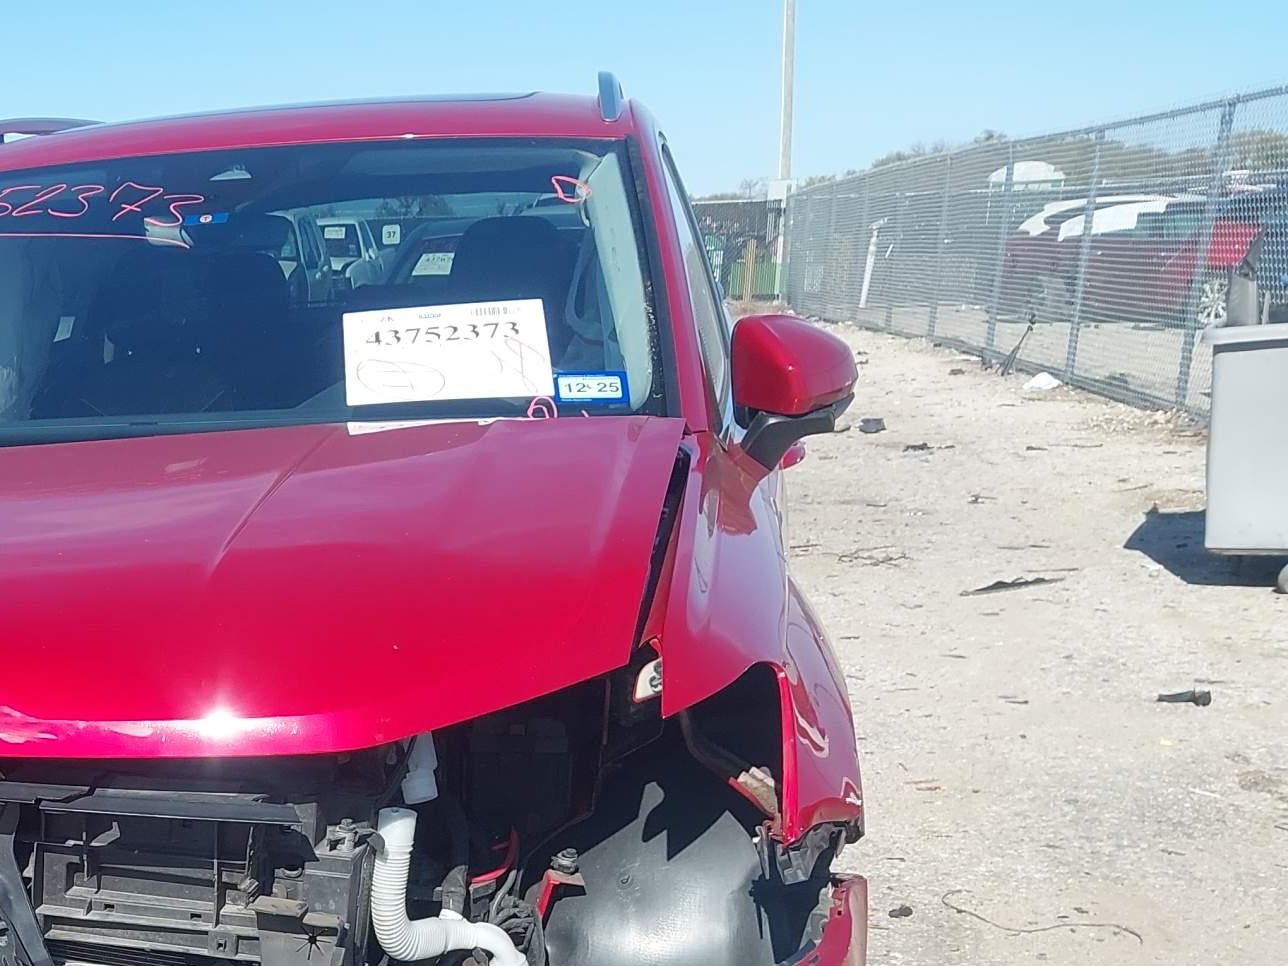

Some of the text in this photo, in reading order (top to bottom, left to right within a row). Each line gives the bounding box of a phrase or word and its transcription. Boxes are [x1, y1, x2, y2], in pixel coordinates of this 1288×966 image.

[386, 230, 396, 239] 37
[365, 321, 520, 346] 43752373
[564, 382, 620, 393] 12 25
